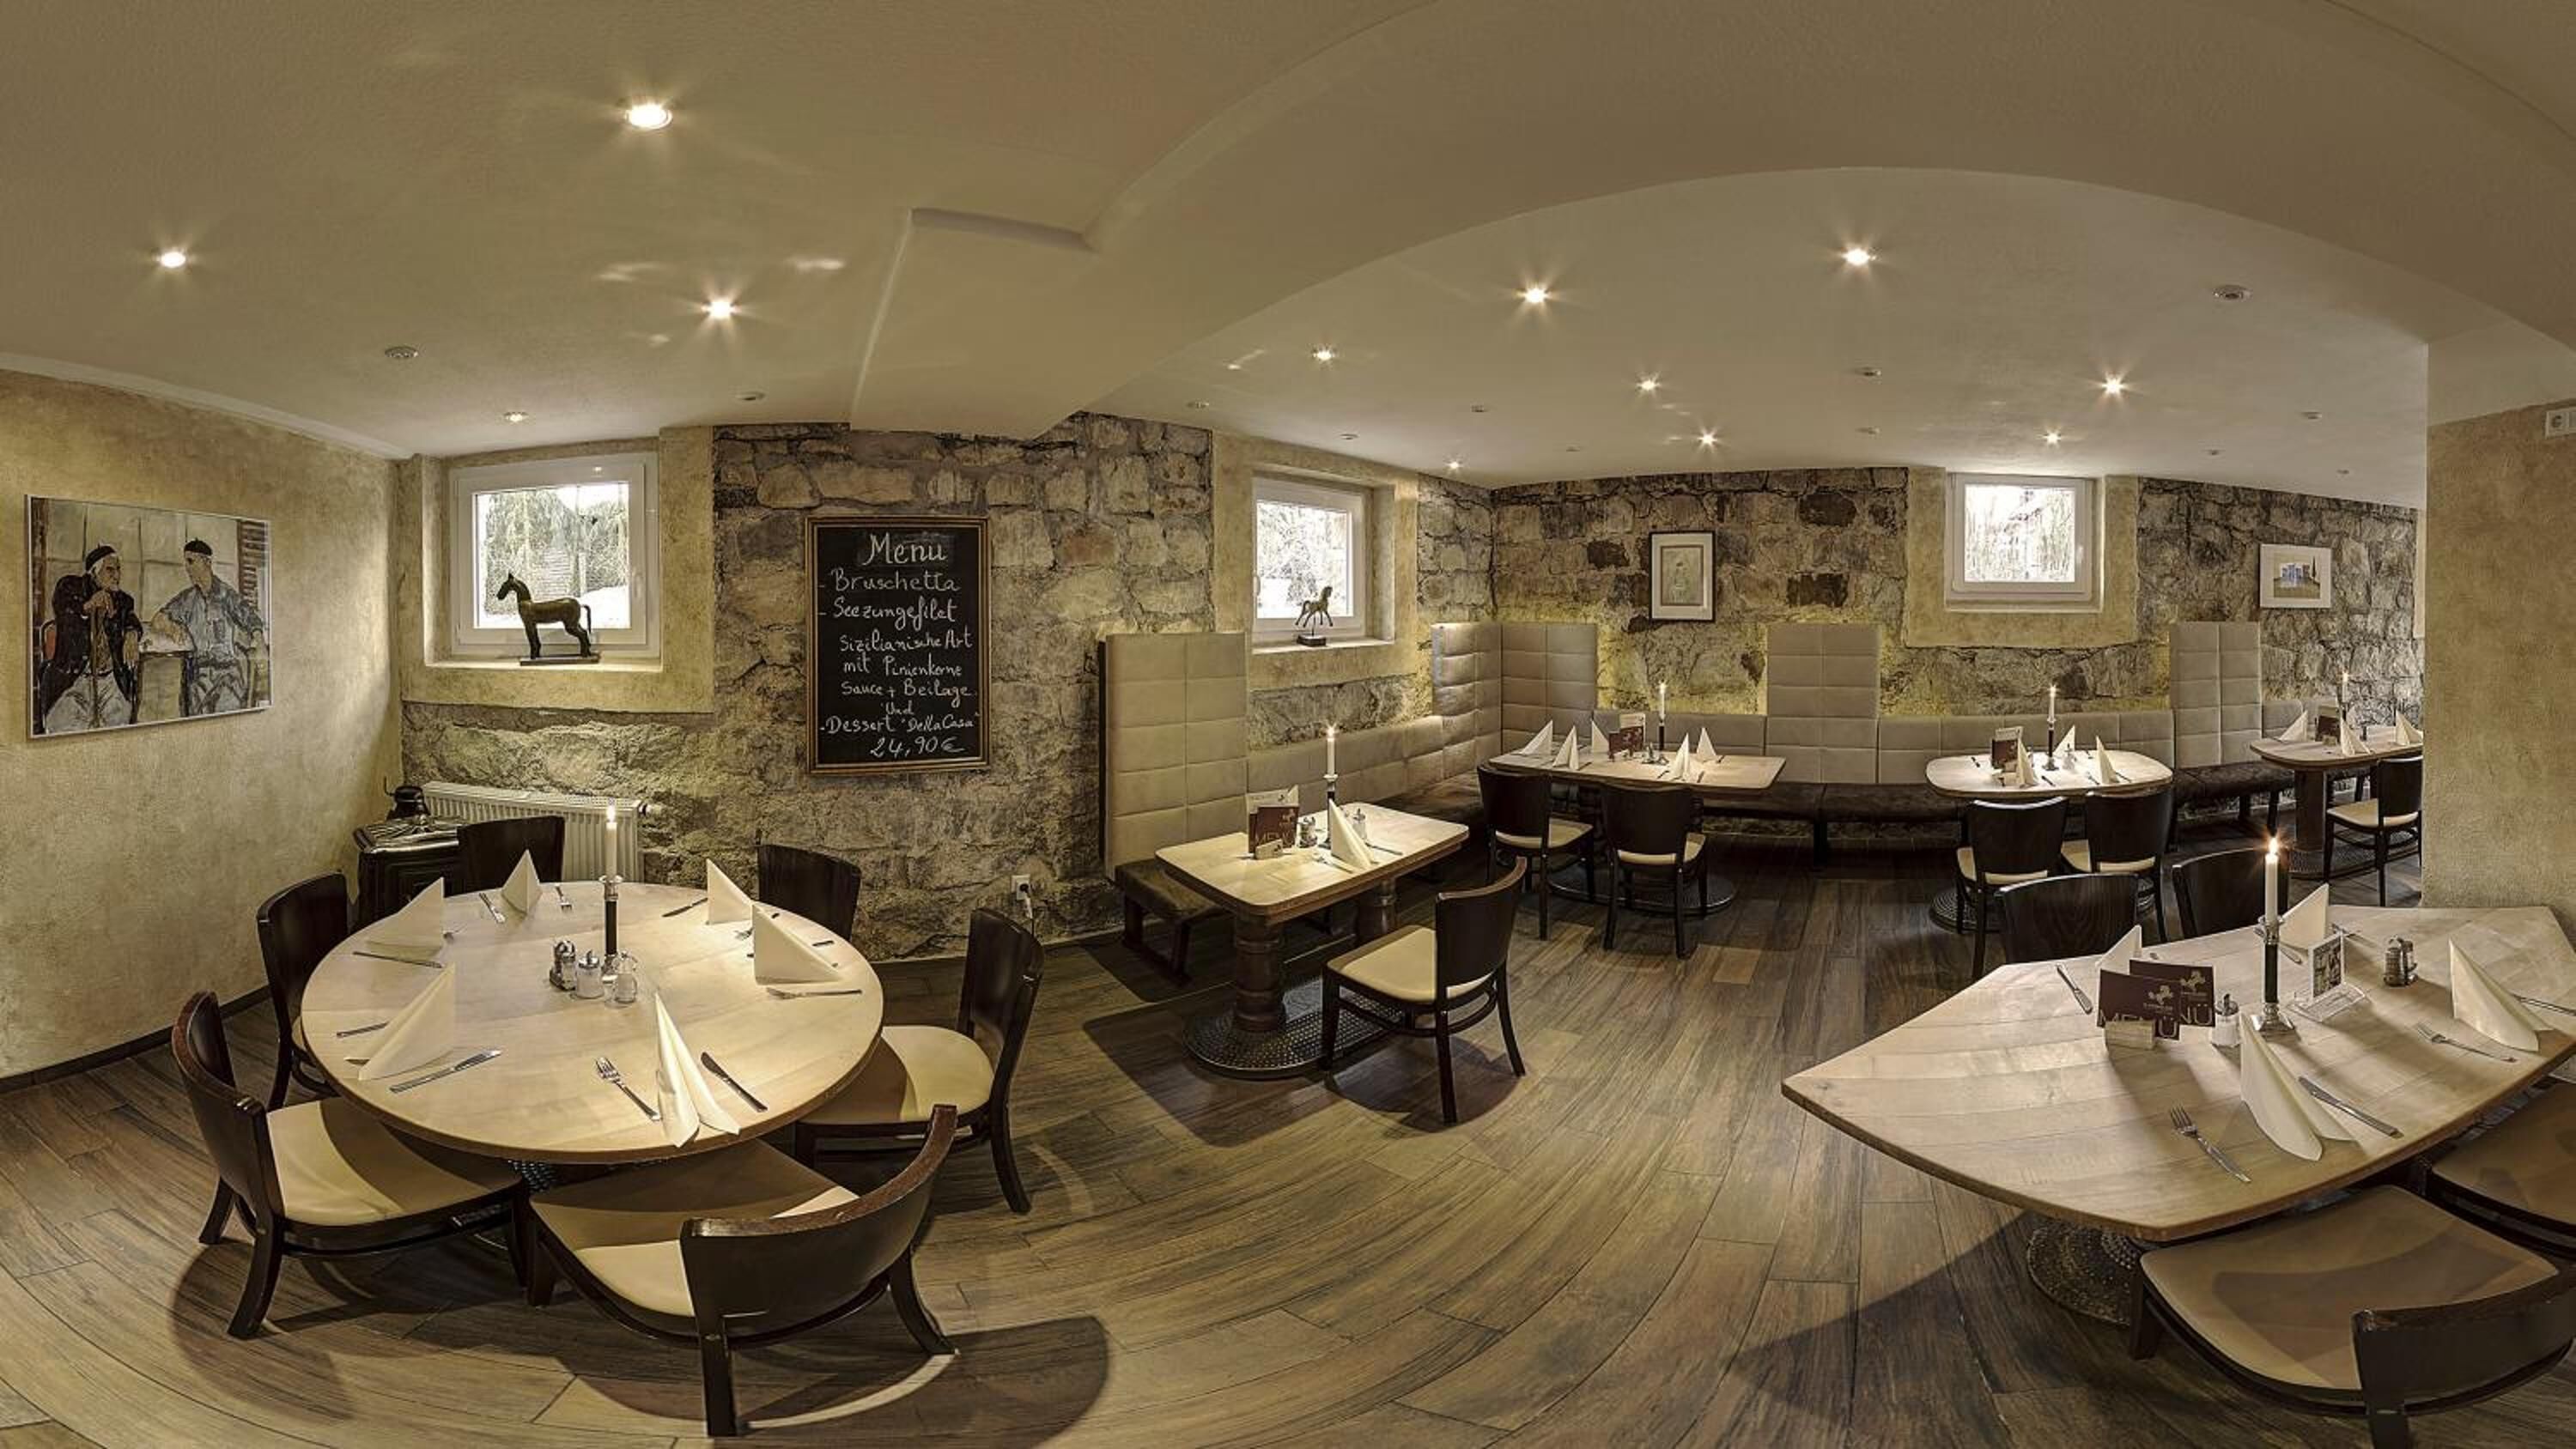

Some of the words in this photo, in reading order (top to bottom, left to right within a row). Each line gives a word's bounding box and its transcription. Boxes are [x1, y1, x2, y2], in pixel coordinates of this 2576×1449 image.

[831, 567, 959, 591] Bruschetta
[945, 625, 973, 649] Art
[844, 652, 871, 673] mit
[841, 681, 883, 695] Sauce
[904, 678, 969, 708] Beilage
